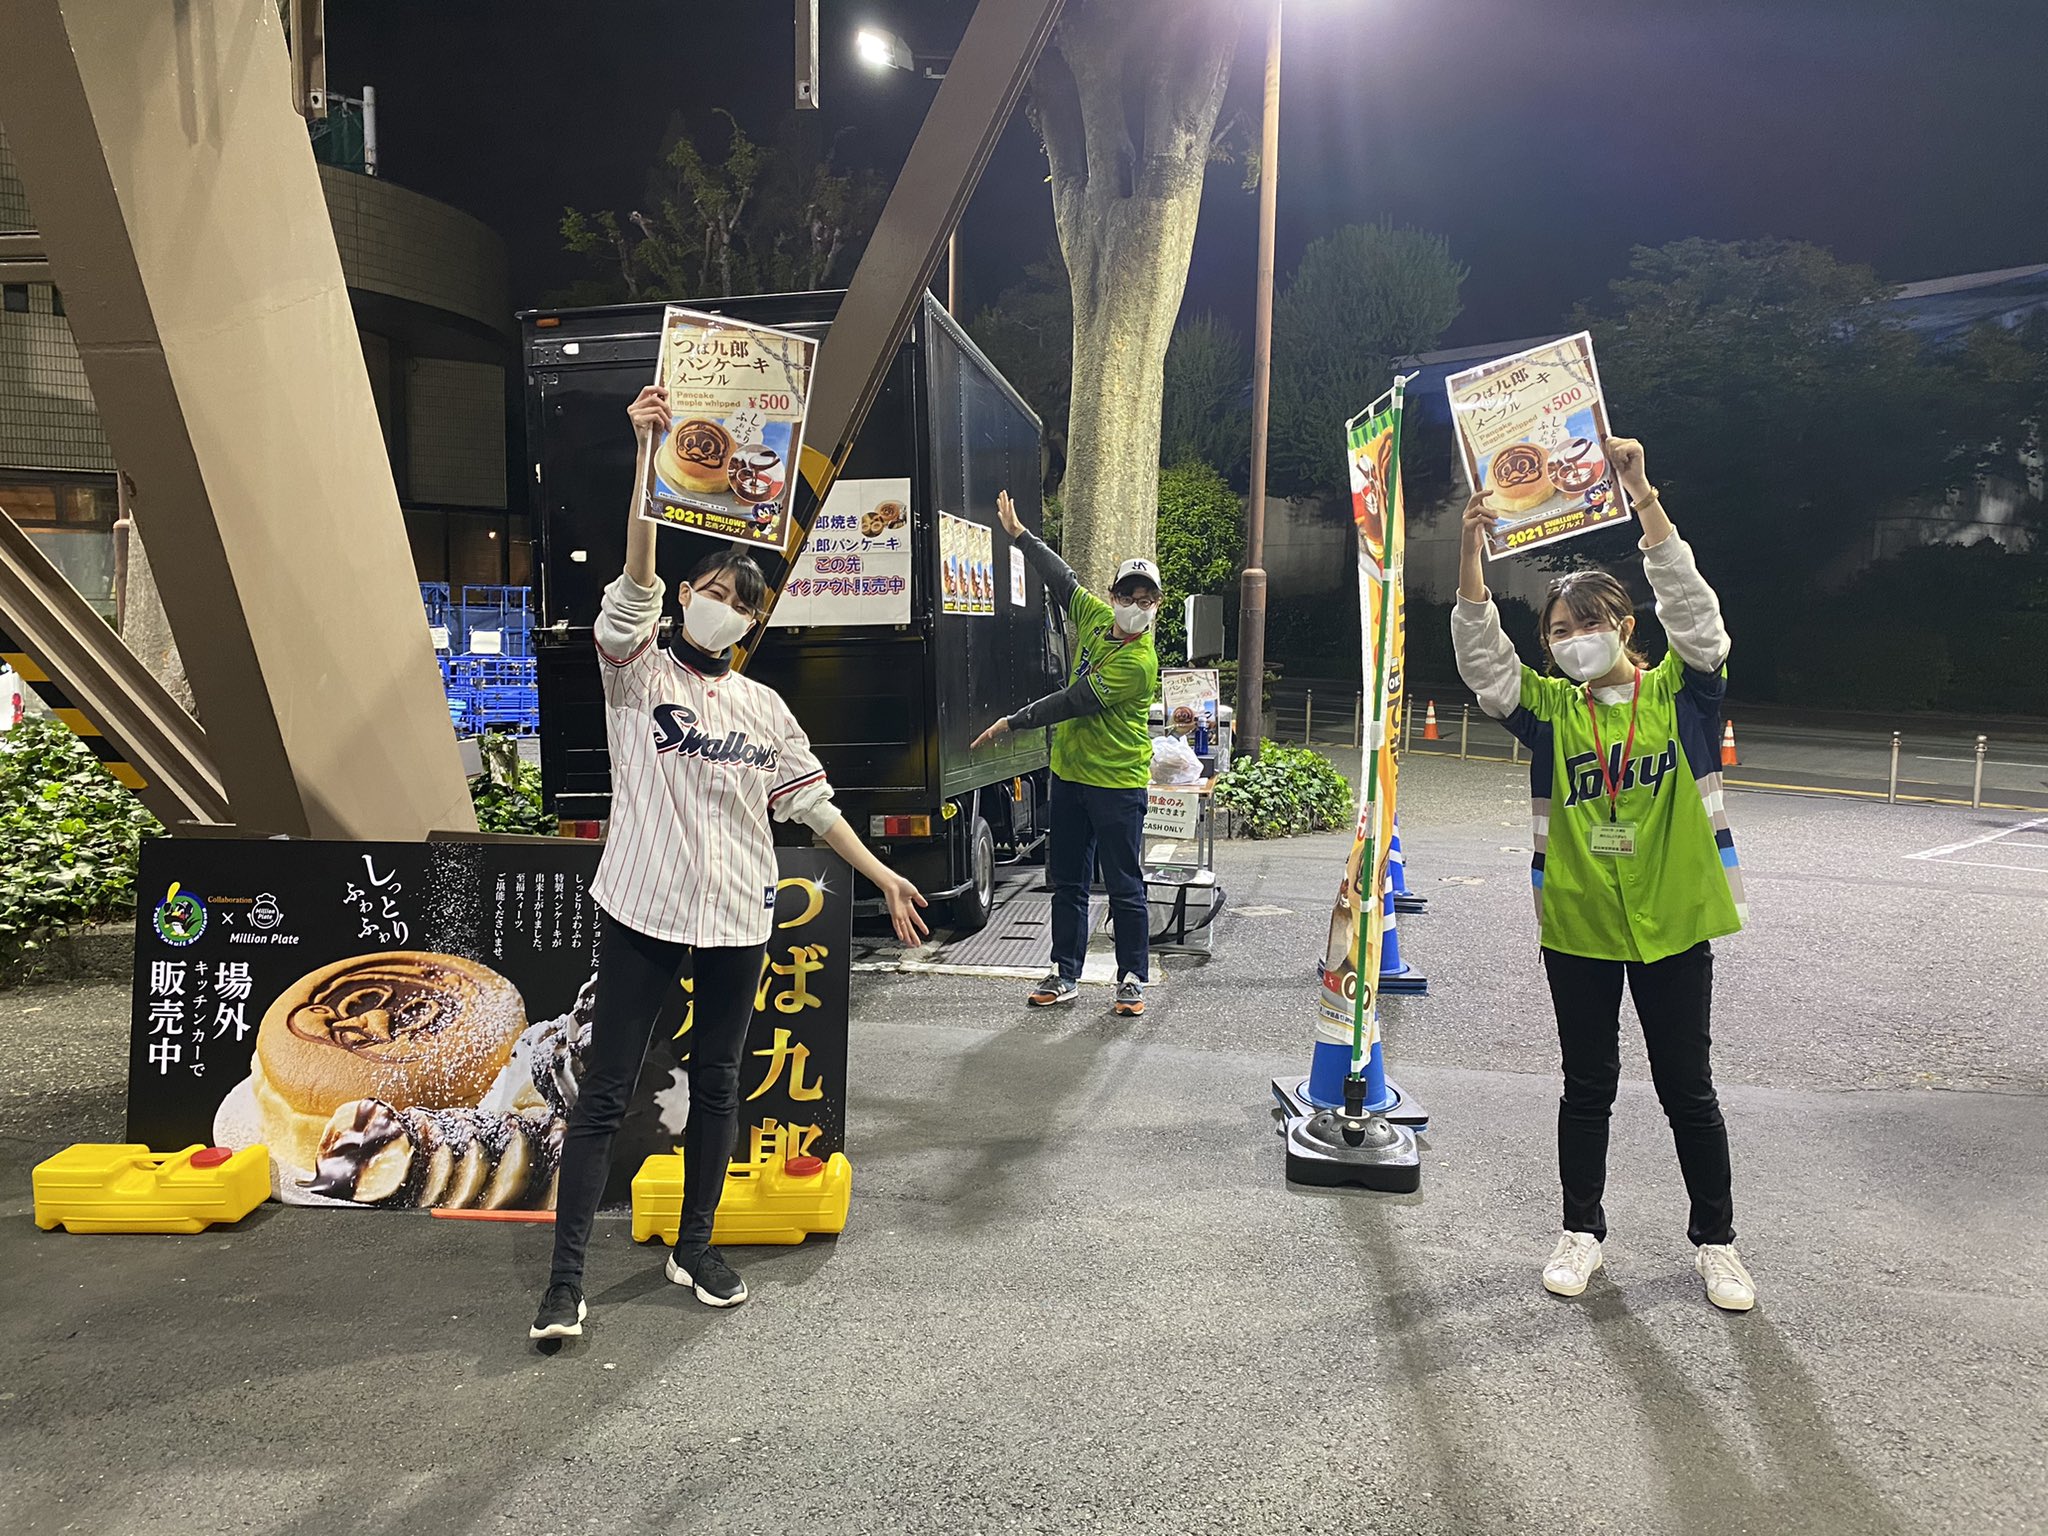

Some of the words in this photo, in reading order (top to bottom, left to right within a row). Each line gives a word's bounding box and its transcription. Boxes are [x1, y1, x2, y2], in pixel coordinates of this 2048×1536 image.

[672, 339, 749, 359] つば九郎
[677, 357, 770, 374] パンケーキ
[676, 372, 730, 386] メープル
[676, 391, 714, 399] Pancake
[676, 398, 703, 407] maple
[704, 400, 741, 408] whipped
[748, 395, 790, 410] ¥500
[1542, 387, 1582, 416] ¥500
[1479, 421, 1513, 441] Pancake
[1482, 431, 1506, 447] maple
[1506, 414, 1538, 433] whipped
[664, 505, 703, 525] 2021
[705, 513, 747, 528] SWALLOWS
[1544, 511, 1585, 528] SWALLOWS
[1506, 525, 1544, 547] 2021
[816, 554, 862, 574] この先
[651, 703, 780, 772] Swallows
[1564, 738, 1679, 808] Tokyo
[1143, 822, 1163, 831] CASH
[1164, 824, 1184, 833] ONLY
[207, 895, 253, 904] Collaboration
[361, 854, 409, 946] しっとり
[343, 882, 391, 944] ふわふわ
[551, 872, 564, 948] 特製パンケーキが
[571, 873, 584, 948] しっとりふわふわ
[229, 932, 267, 944] Million
[270, 933, 299, 945] Plate
[213, 961, 253, 1042] 場外
[148, 960, 188, 1075] 販売中
[189, 960, 209, 1077] キッチンカーで
